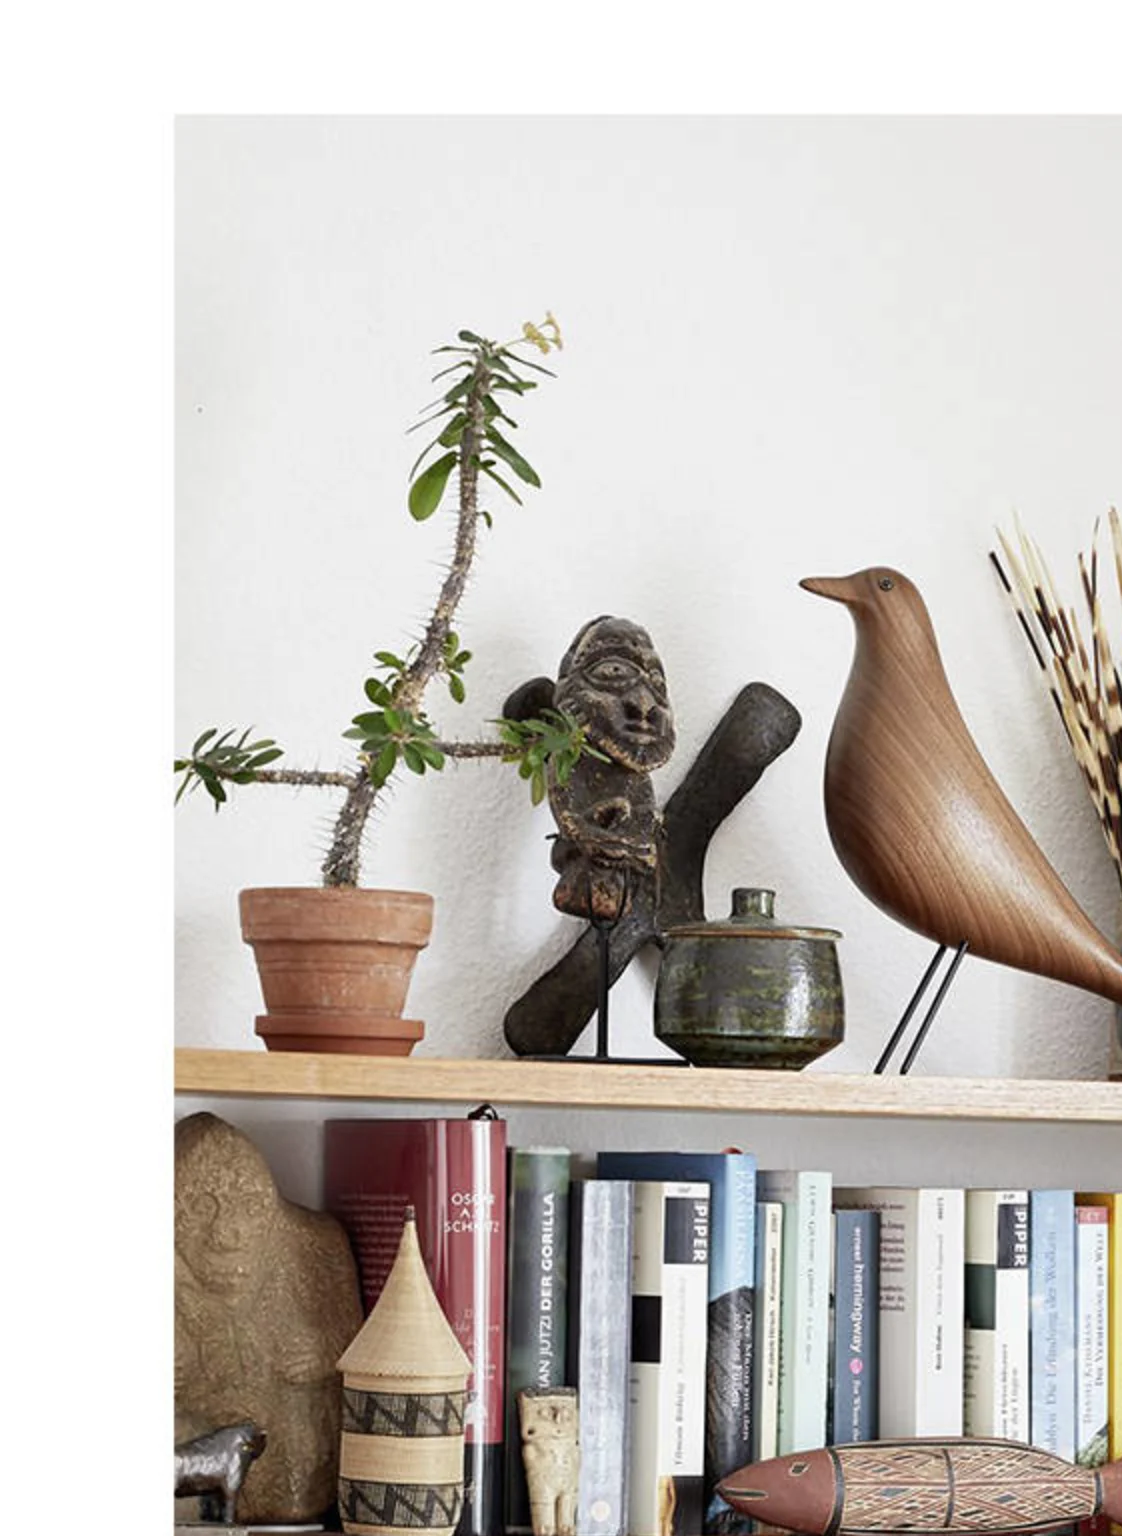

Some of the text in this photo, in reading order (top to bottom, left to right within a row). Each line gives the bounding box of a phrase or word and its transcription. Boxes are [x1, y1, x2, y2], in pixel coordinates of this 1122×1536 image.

[538, 1192, 558, 1358] JUTZI DER GORILLA
[693, 1204, 708, 1262] PIPER
[1013, 1210, 1027, 1268] PIPER
[849, 1227, 864, 1353] ernest hemingway
